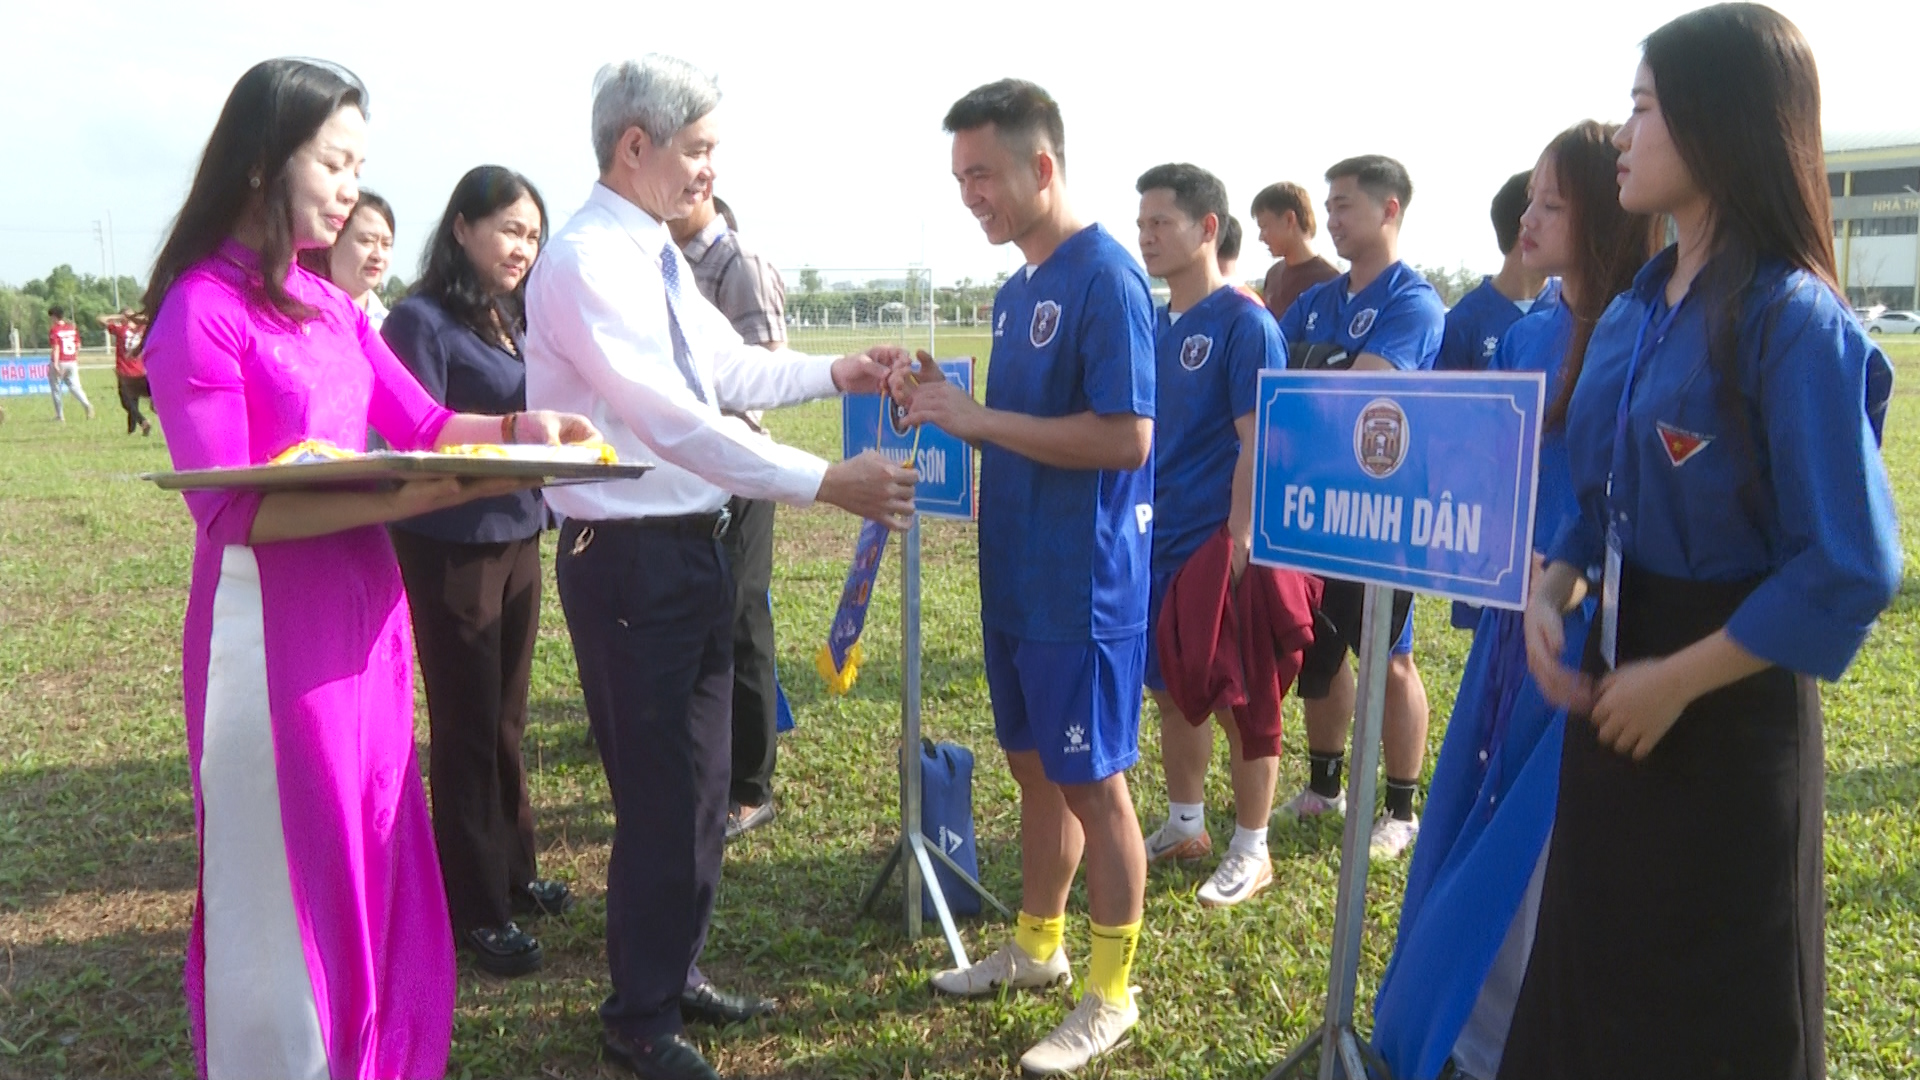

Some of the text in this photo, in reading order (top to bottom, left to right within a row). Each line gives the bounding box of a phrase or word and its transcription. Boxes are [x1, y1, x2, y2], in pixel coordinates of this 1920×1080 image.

[917, 446, 946, 484] SƠN
[1283, 484, 1482, 555] FC MINH DÂN
